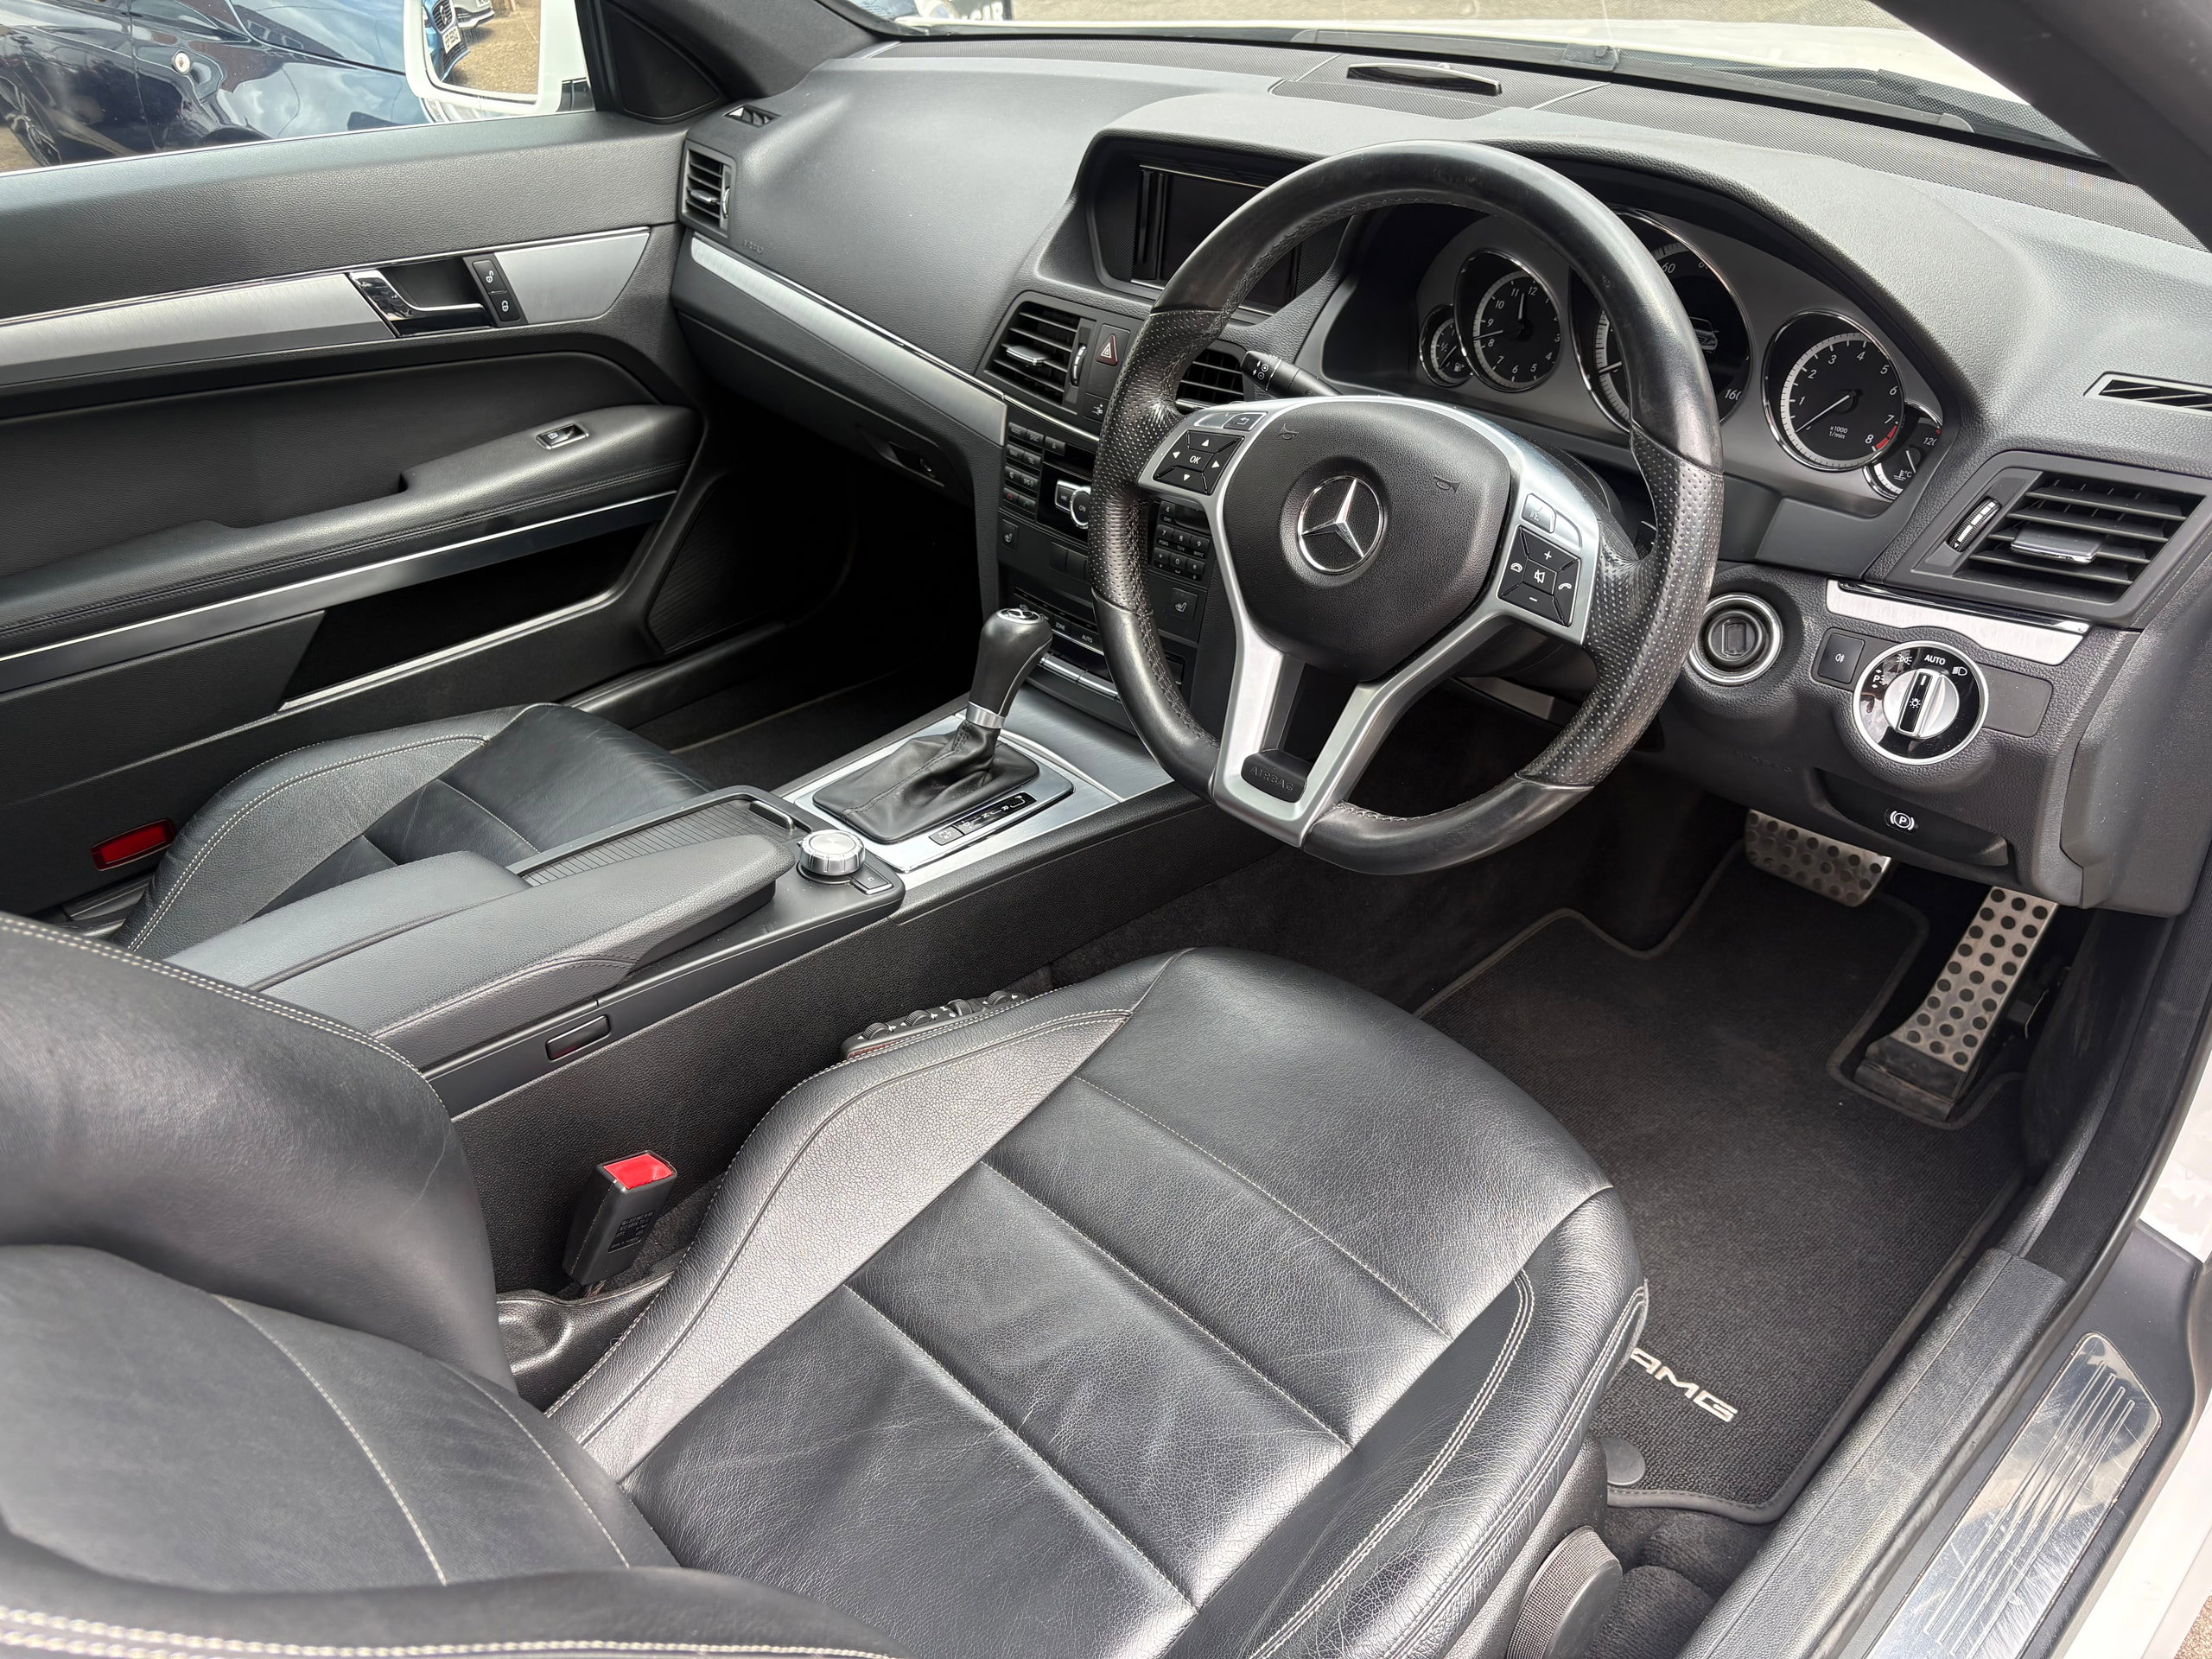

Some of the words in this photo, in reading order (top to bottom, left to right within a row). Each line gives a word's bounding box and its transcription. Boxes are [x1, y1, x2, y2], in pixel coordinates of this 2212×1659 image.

[1511, 288, 1520, 297] 11
[1528, 287, 1538, 296] 12
[1495, 300, 1505, 309] 10
[1487, 318, 1494, 327] 9
[1488, 339, 1495, 347] 8
[1497, 356, 1504, 364] 7
[1545, 352, 1553, 360] 4
[1828, 355, 1837, 364] 3
[1857, 351, 1865, 361] 4
[1512, 365, 1518, 374] 6
[1530, 363, 1537, 372] 5
[1880, 365, 1890, 375] 5
[1808, 369, 1817, 379] 2
[1889, 386, 1897, 395] 6
[1799, 396, 1805, 405] 1
[1884, 414, 1894, 424] 7
[1865, 434, 1874, 444] 8
[1189, 456, 1201, 464] OK
[1924, 654, 1946, 665] AUTO
[1250, 766, 1293, 791] AIRBAG
[1630, 1348, 1738, 1423] AMG
